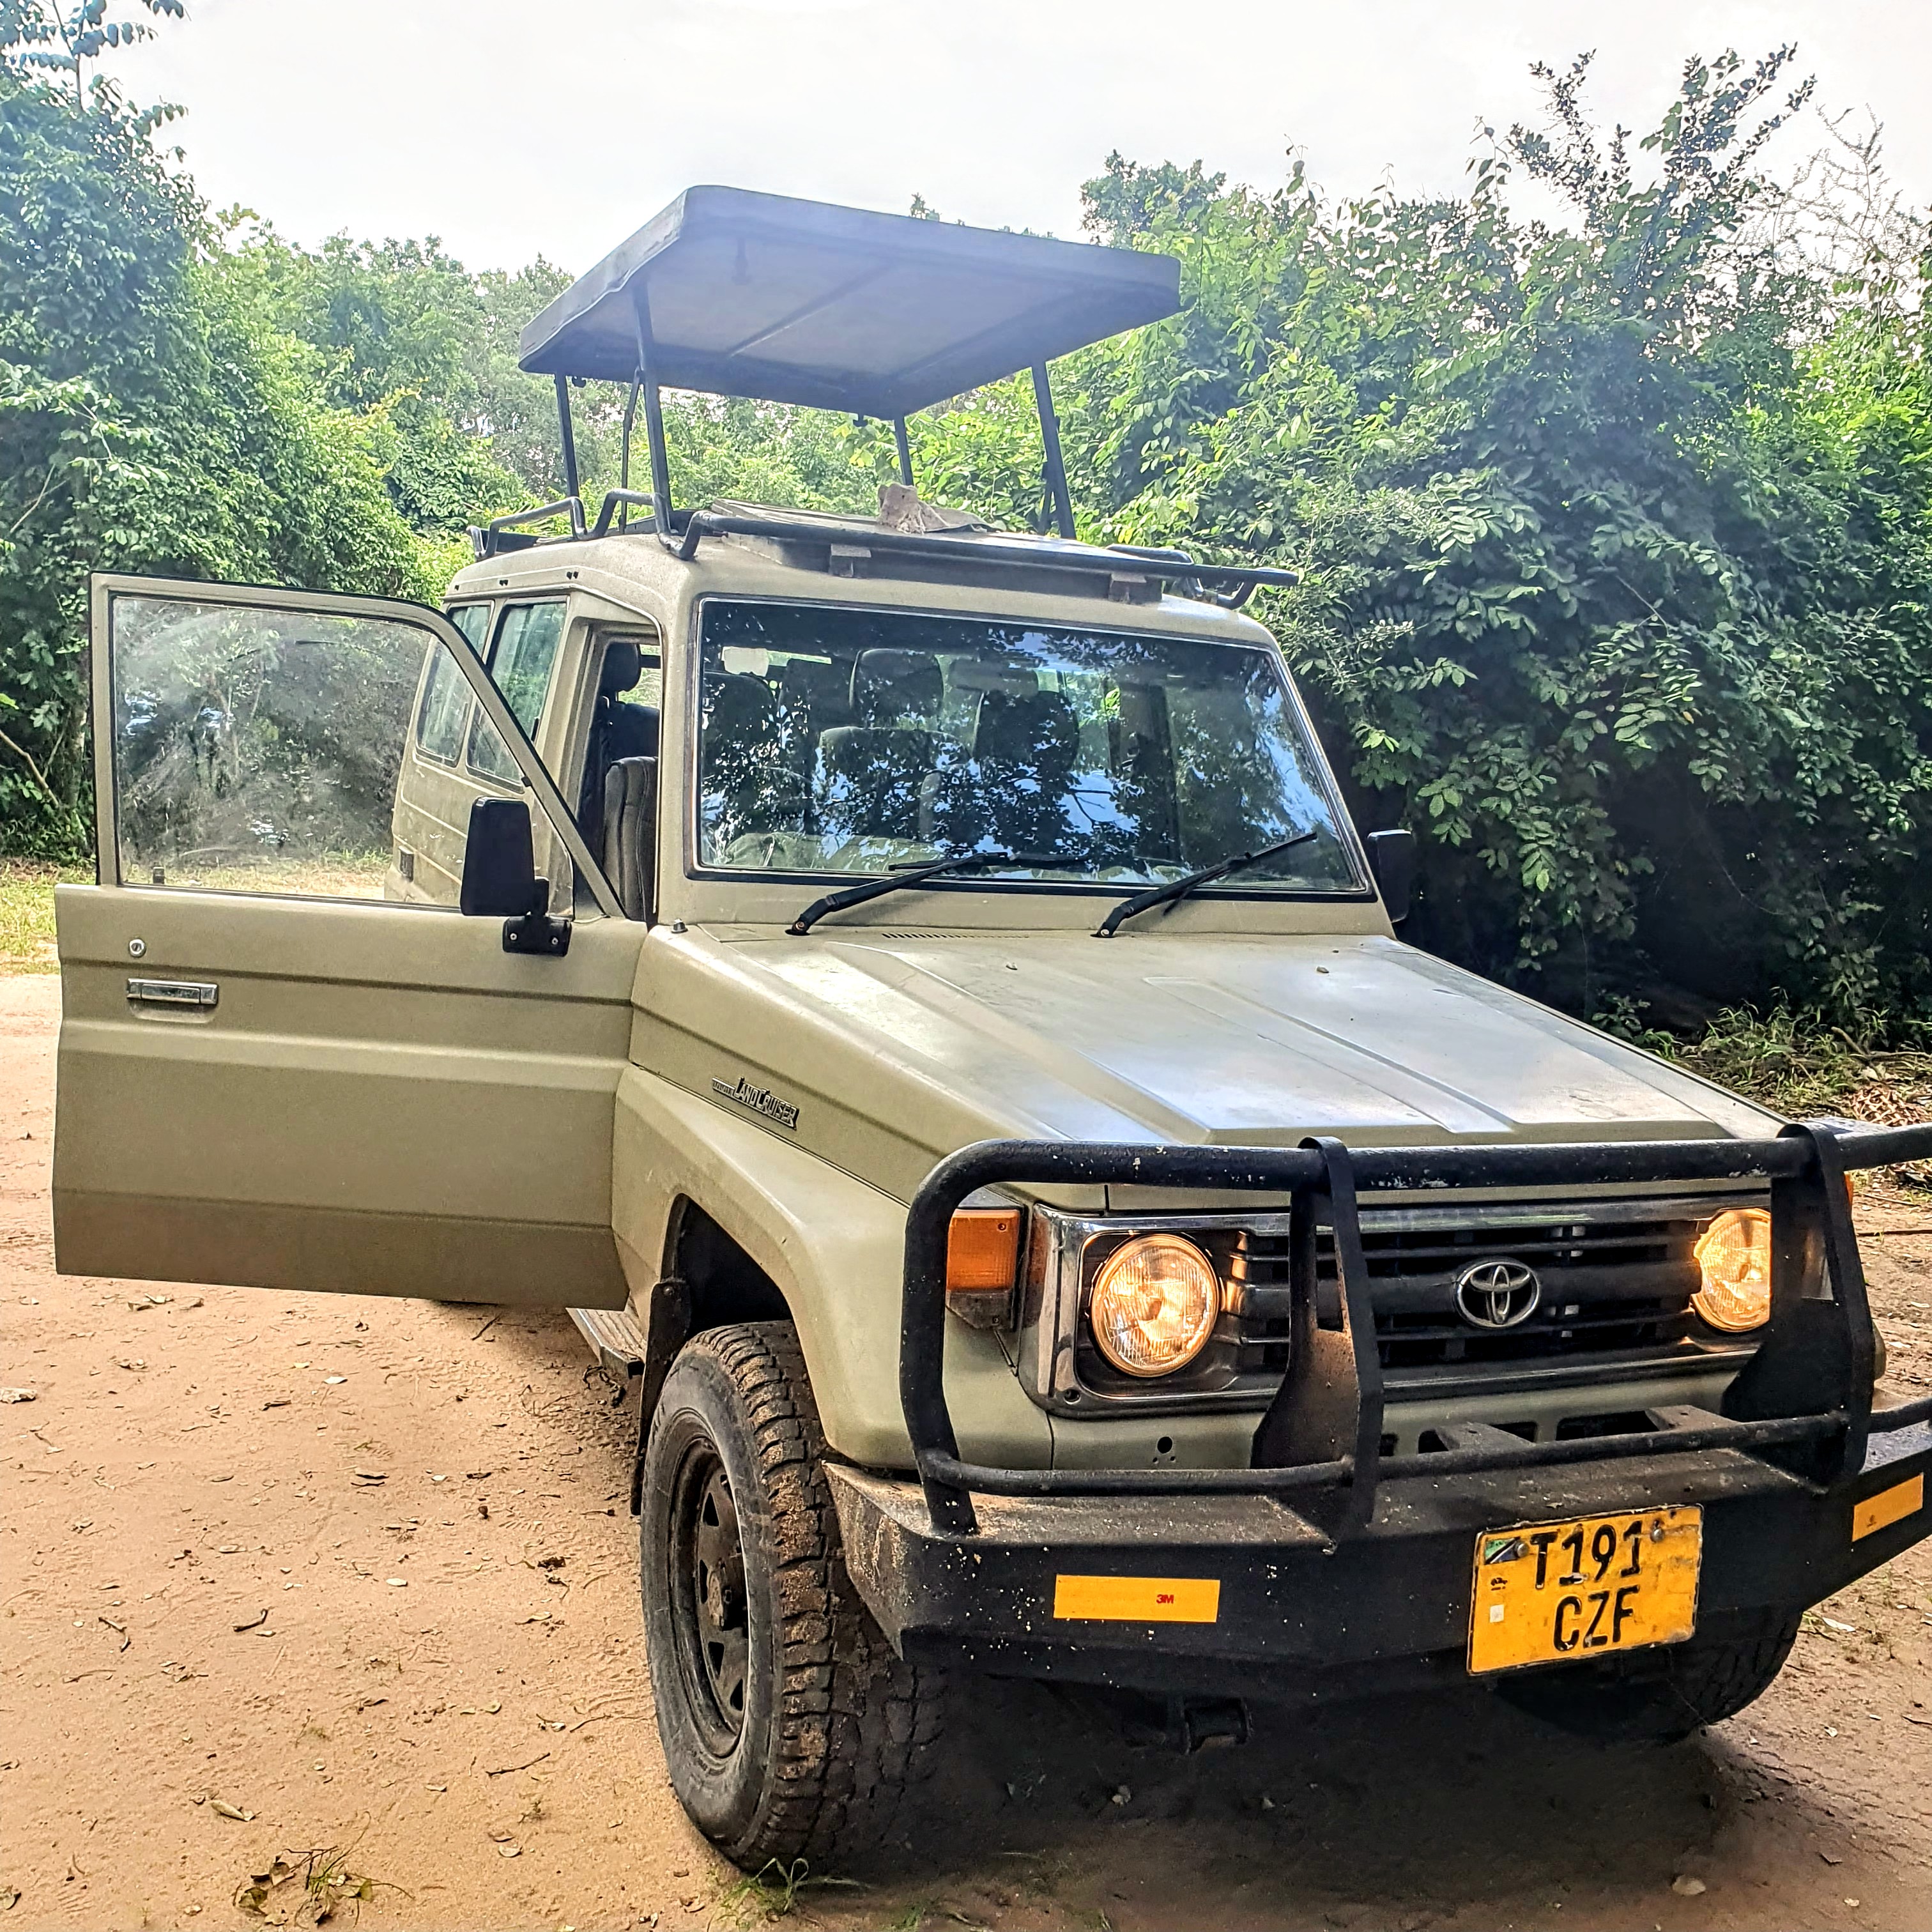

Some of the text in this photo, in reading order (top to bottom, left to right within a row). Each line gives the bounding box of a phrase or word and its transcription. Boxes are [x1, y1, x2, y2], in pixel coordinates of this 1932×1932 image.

[1530, 1521, 1643, 1590] T191
[1156, 1594, 1174, 1604] 3M
[1553, 1584, 1640, 1652] CZF
